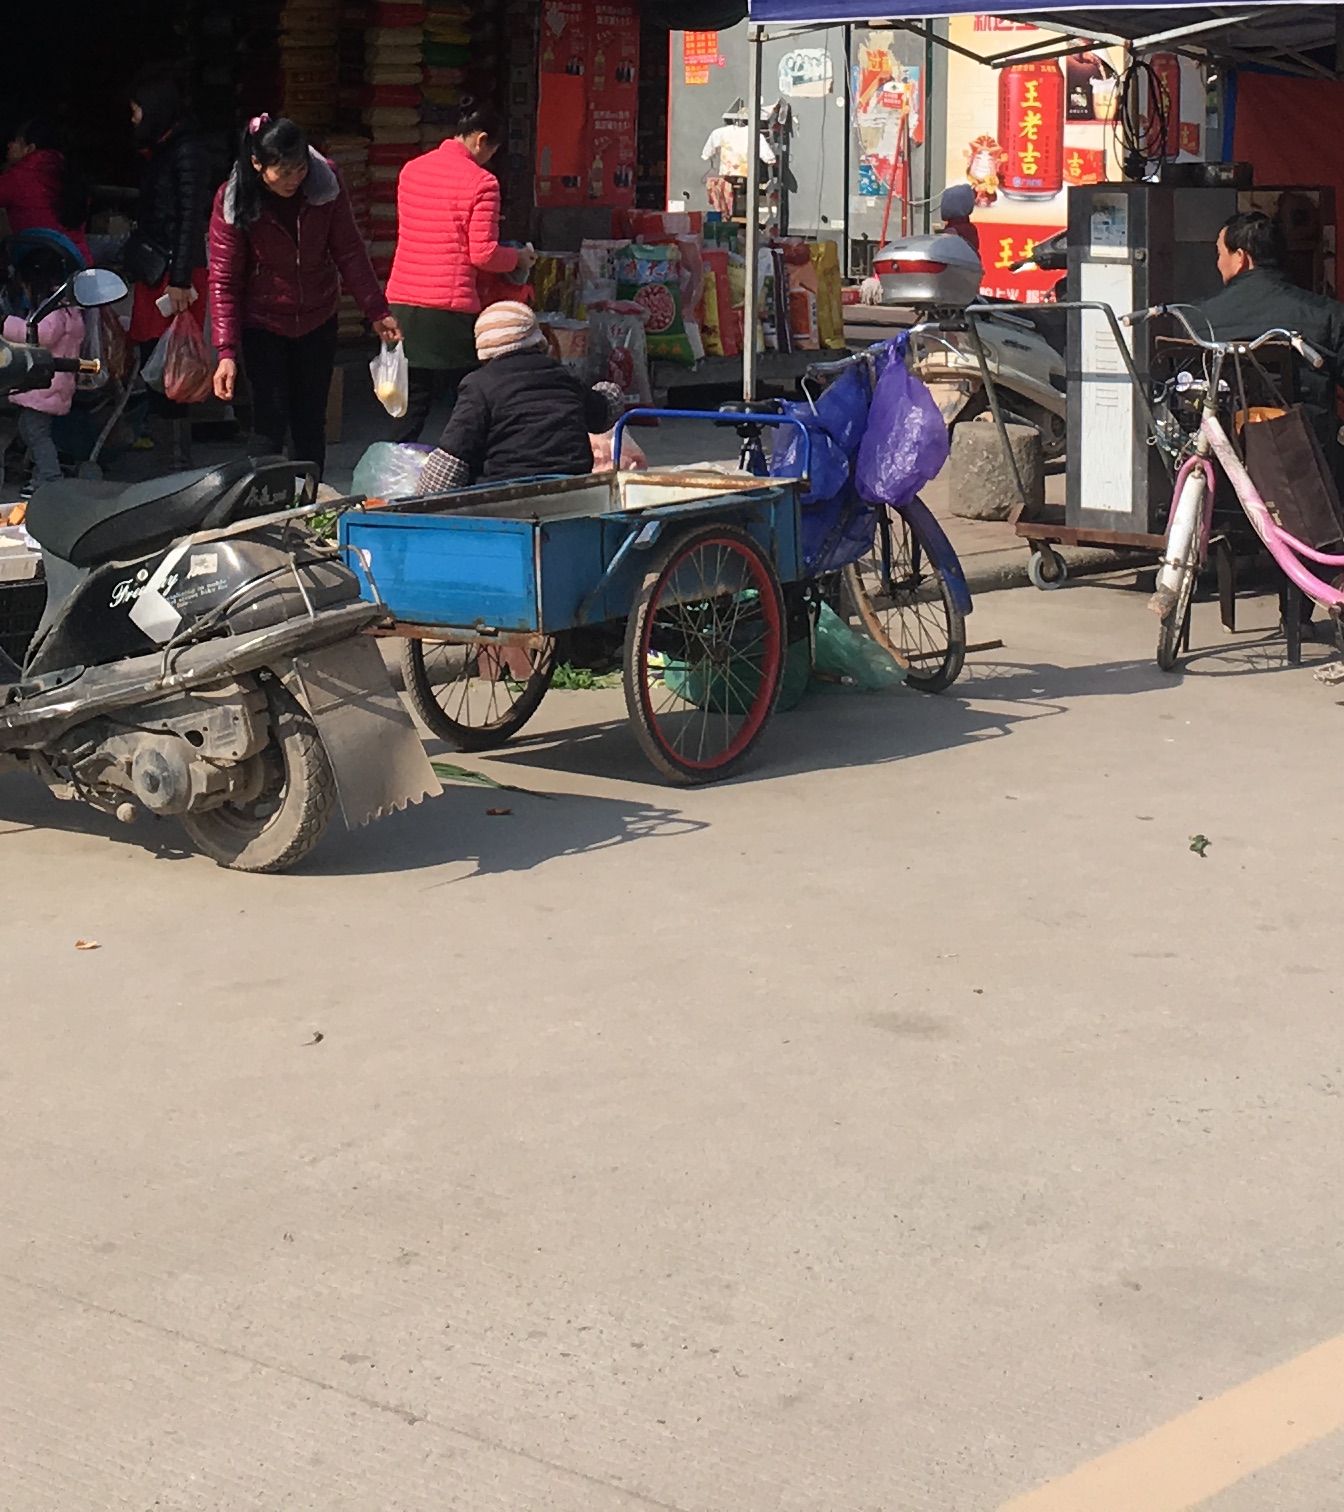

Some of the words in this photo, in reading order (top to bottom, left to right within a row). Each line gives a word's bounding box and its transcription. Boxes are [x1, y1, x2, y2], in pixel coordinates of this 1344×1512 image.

[1017, 79, 1043, 176] 王老吉
[1066, 151, 1085, 177] 吉
